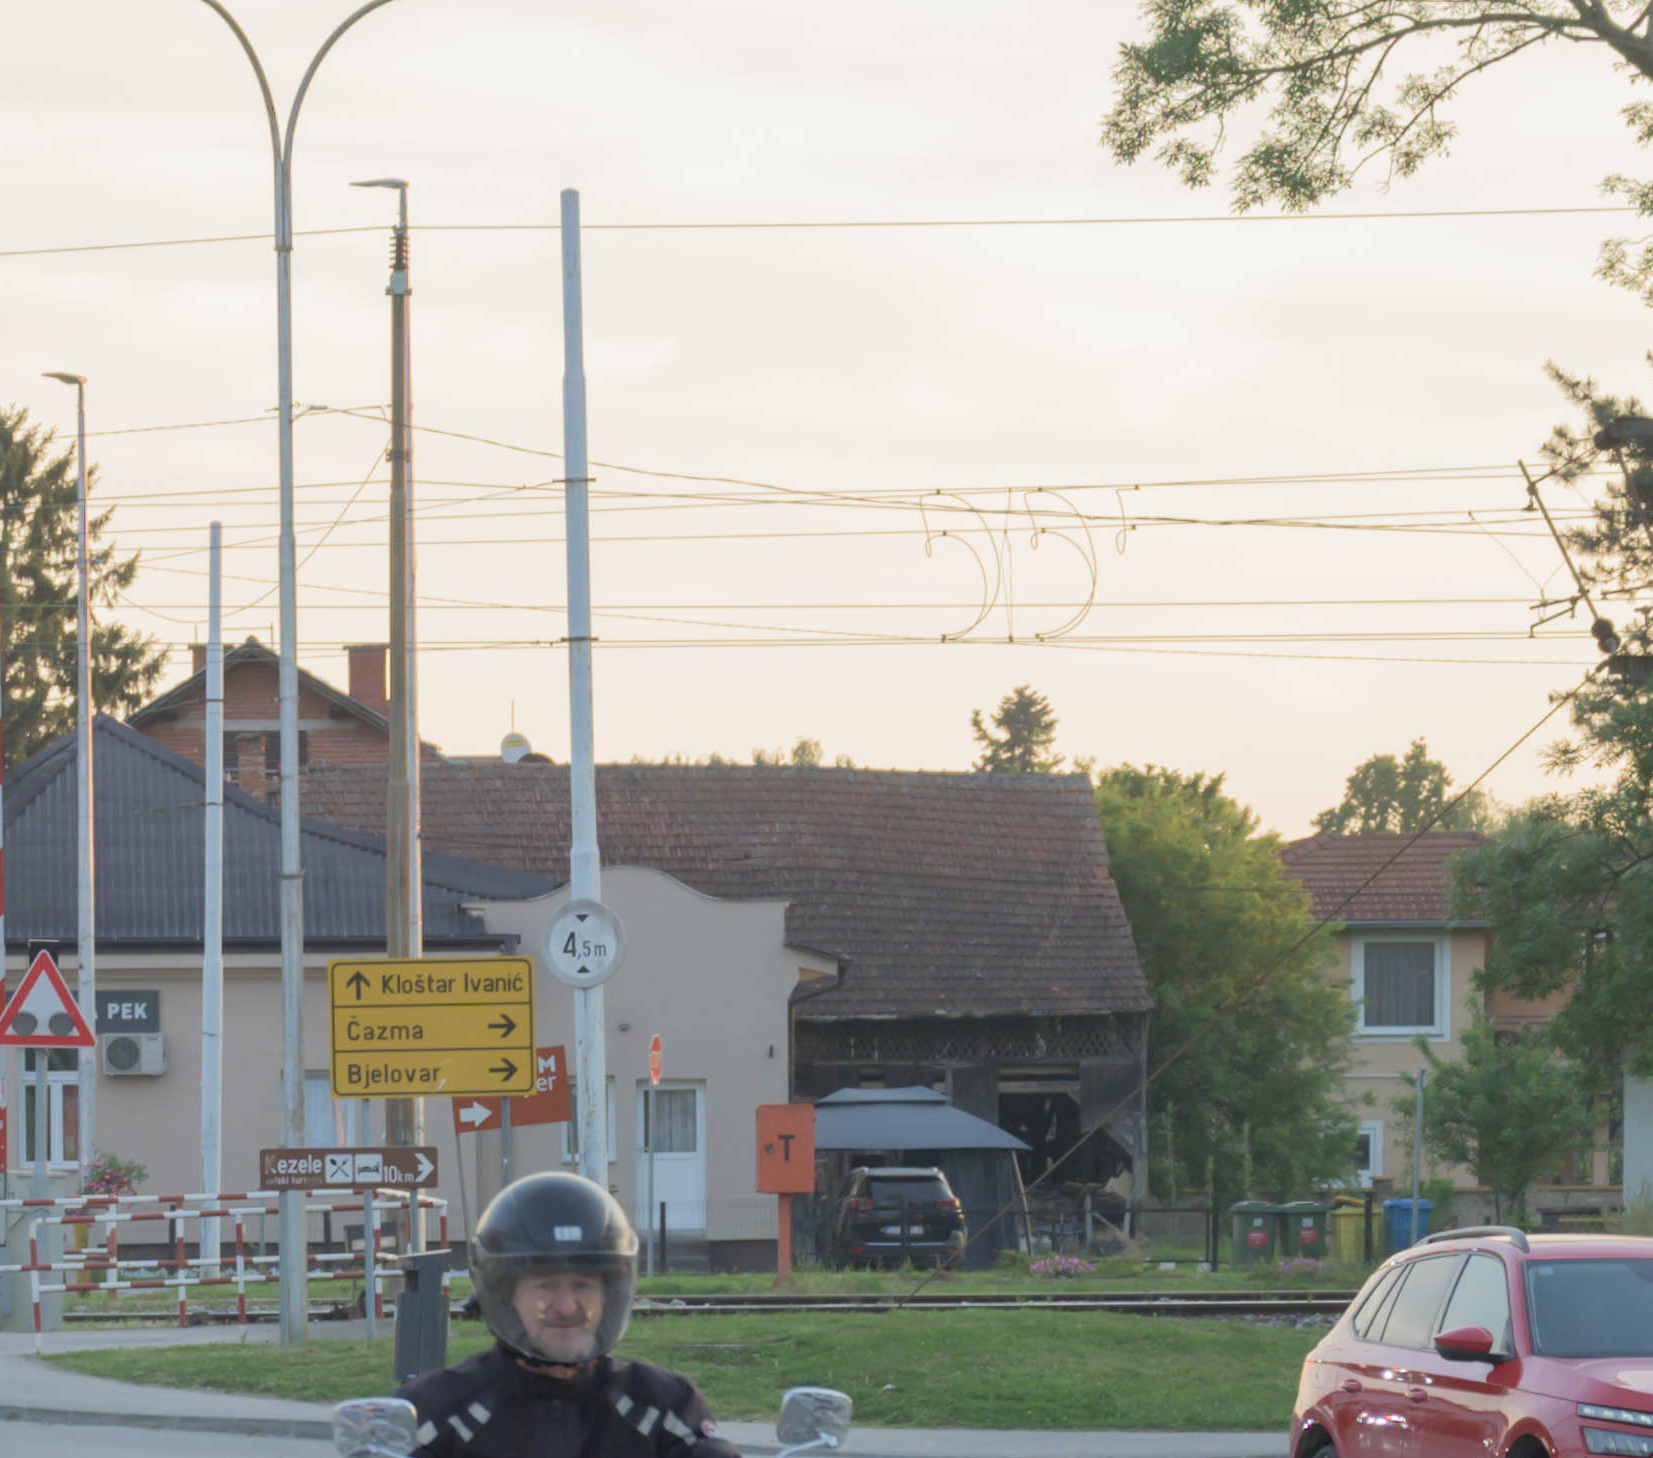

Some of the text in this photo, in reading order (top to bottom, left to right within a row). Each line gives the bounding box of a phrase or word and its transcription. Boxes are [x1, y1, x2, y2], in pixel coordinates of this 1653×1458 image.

[382, 972, 524, 994] Kloštar Ivanić
[107, 1002, 148, 1020] PEK
[347, 1015, 424, 1041] Čazma
[348, 1063, 441, 1089] Bjelovar
[778, 1133, 796, 1162] T
